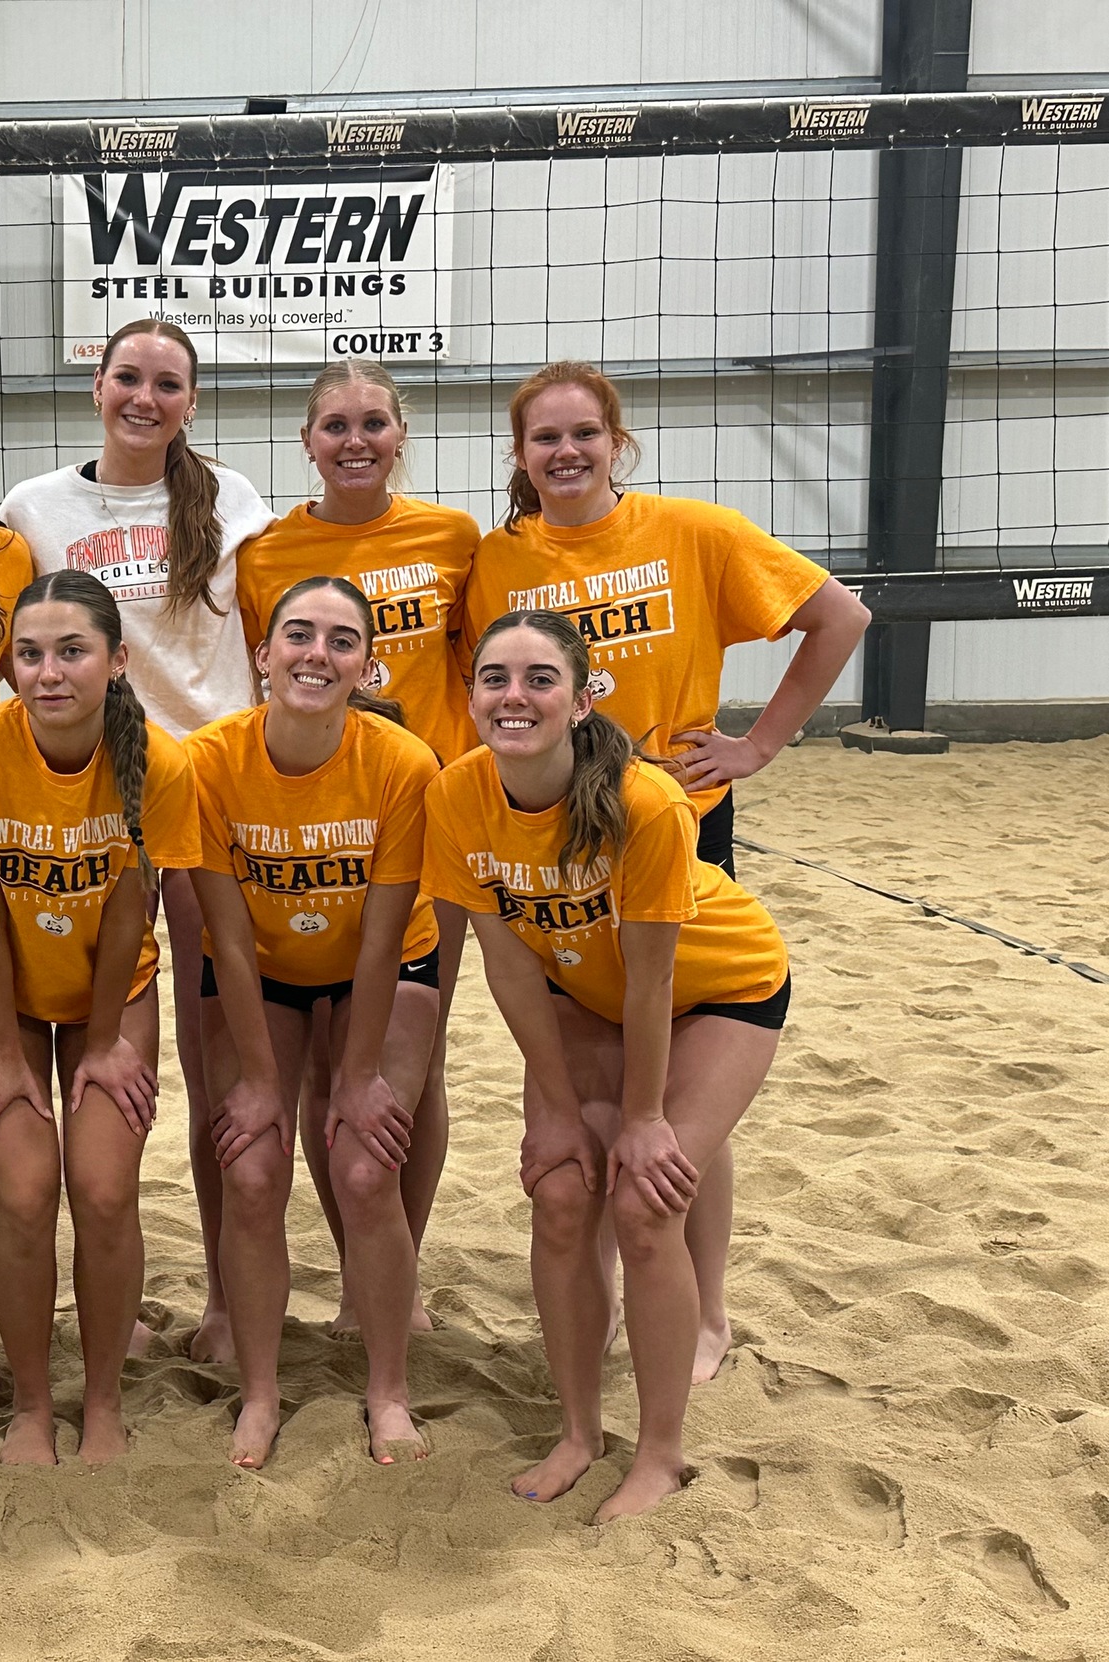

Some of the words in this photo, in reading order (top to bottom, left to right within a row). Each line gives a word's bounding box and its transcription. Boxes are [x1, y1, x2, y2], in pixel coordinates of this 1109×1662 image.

[789, 104, 869, 128] WESTERN
[1022, 98, 1102, 122] WESTERN
[326, 120, 404, 143] WESTERN
[557, 112, 636, 136] WESTERN
[791, 129, 814, 137] STEEL
[818, 128, 864, 136] BUILDINGS
[1051, 122, 1098, 130] BUILDINGS
[99, 127, 176, 150] WESTERN
[355, 143, 401, 151] BUILDINGS
[558, 138, 581, 146] STEEL
[585, 136, 632, 144] BUILDINGS
[102, 151, 124, 160] STEEL
[128, 150, 173, 159] BUILDINGS
[83, 170, 425, 265] WESTERN
[91, 277, 188, 299] STEEL
[209, 274, 406, 298] BUILDINGS
[218, 311, 244, 324] has
[250, 314, 276, 328] you
[333, 333, 421, 354] COURT
[429, 332, 443, 352] 3
[66, 527, 130, 573] CENTRAL
[101, 563, 168, 580] COLLEG
[113, 584, 165, 599] RUSTLER
[508, 580, 579, 612] CENTRAL
[584, 559, 669, 601] WYOMING
[1012, 580, 1093, 600] WESTERN
[578, 602, 651, 643] ACH
[299, 818, 378, 850] WYOMIN
[244, 857, 368, 890] BEACH
